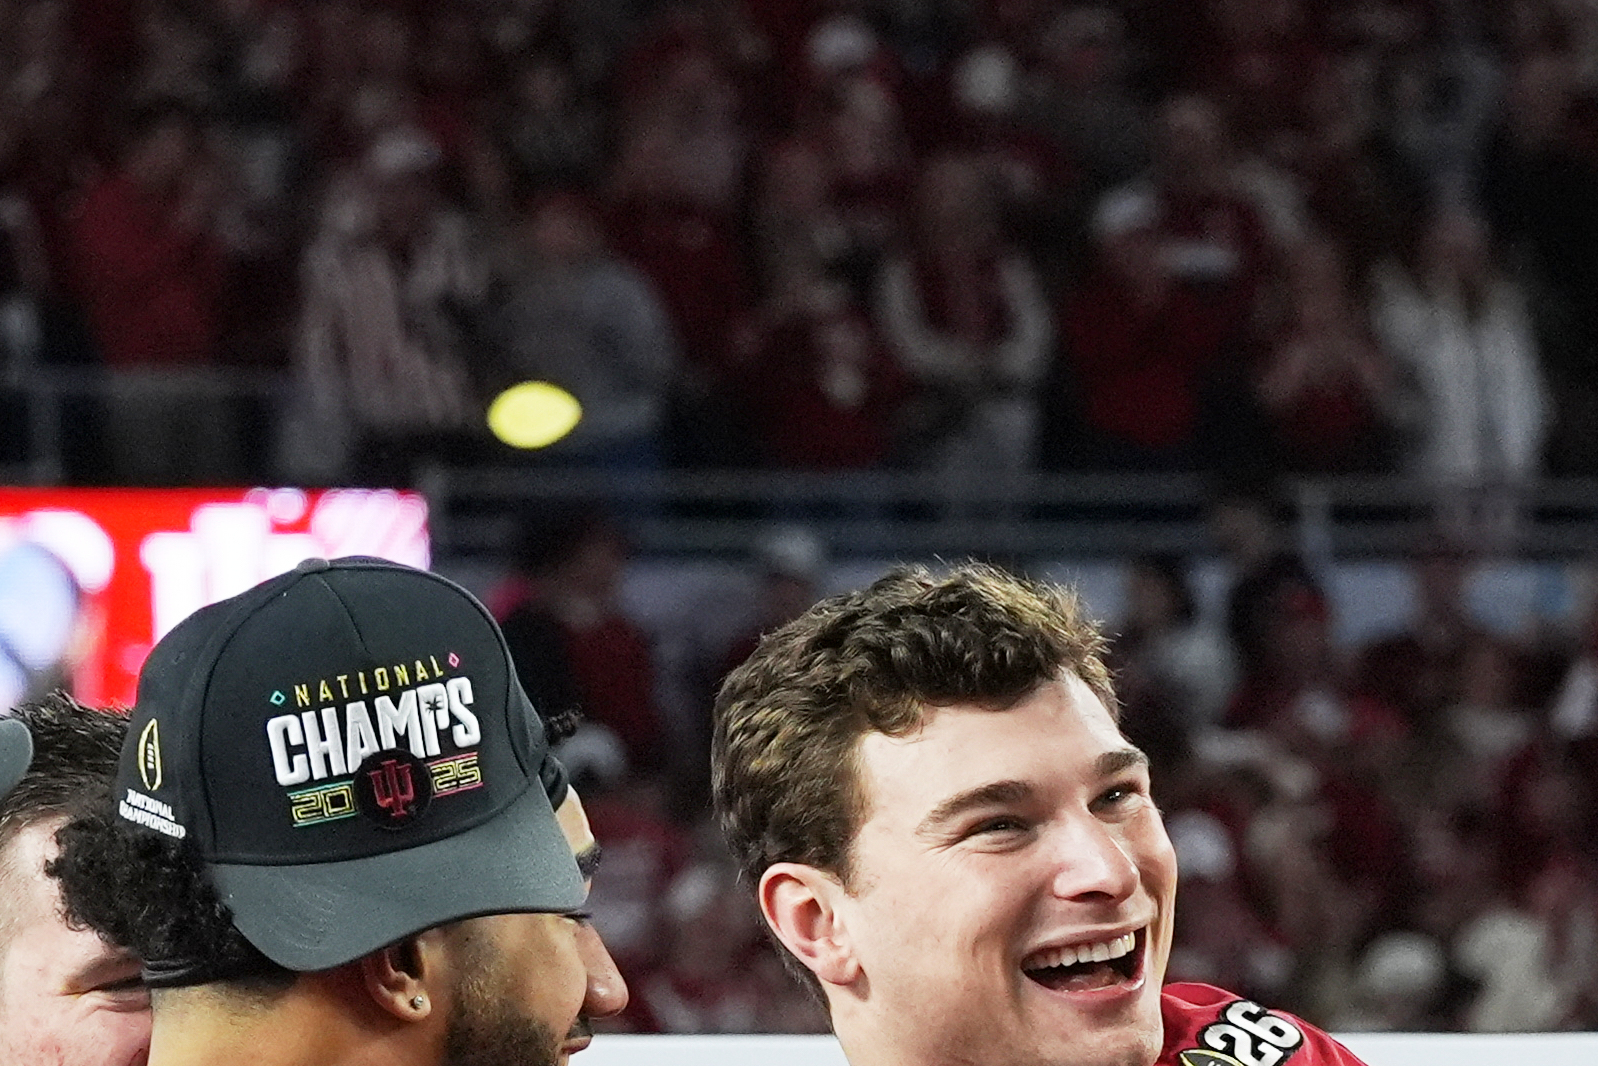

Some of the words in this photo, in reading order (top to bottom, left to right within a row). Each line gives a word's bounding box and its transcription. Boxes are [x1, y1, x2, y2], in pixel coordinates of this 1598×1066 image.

[294, 655, 444, 708] NATIONAL
[266, 676, 482, 787] CHAMPS
[126, 788, 175, 821] NATIONAL
[290, 784, 356, 824] 20
[430, 755, 482, 793] 25
